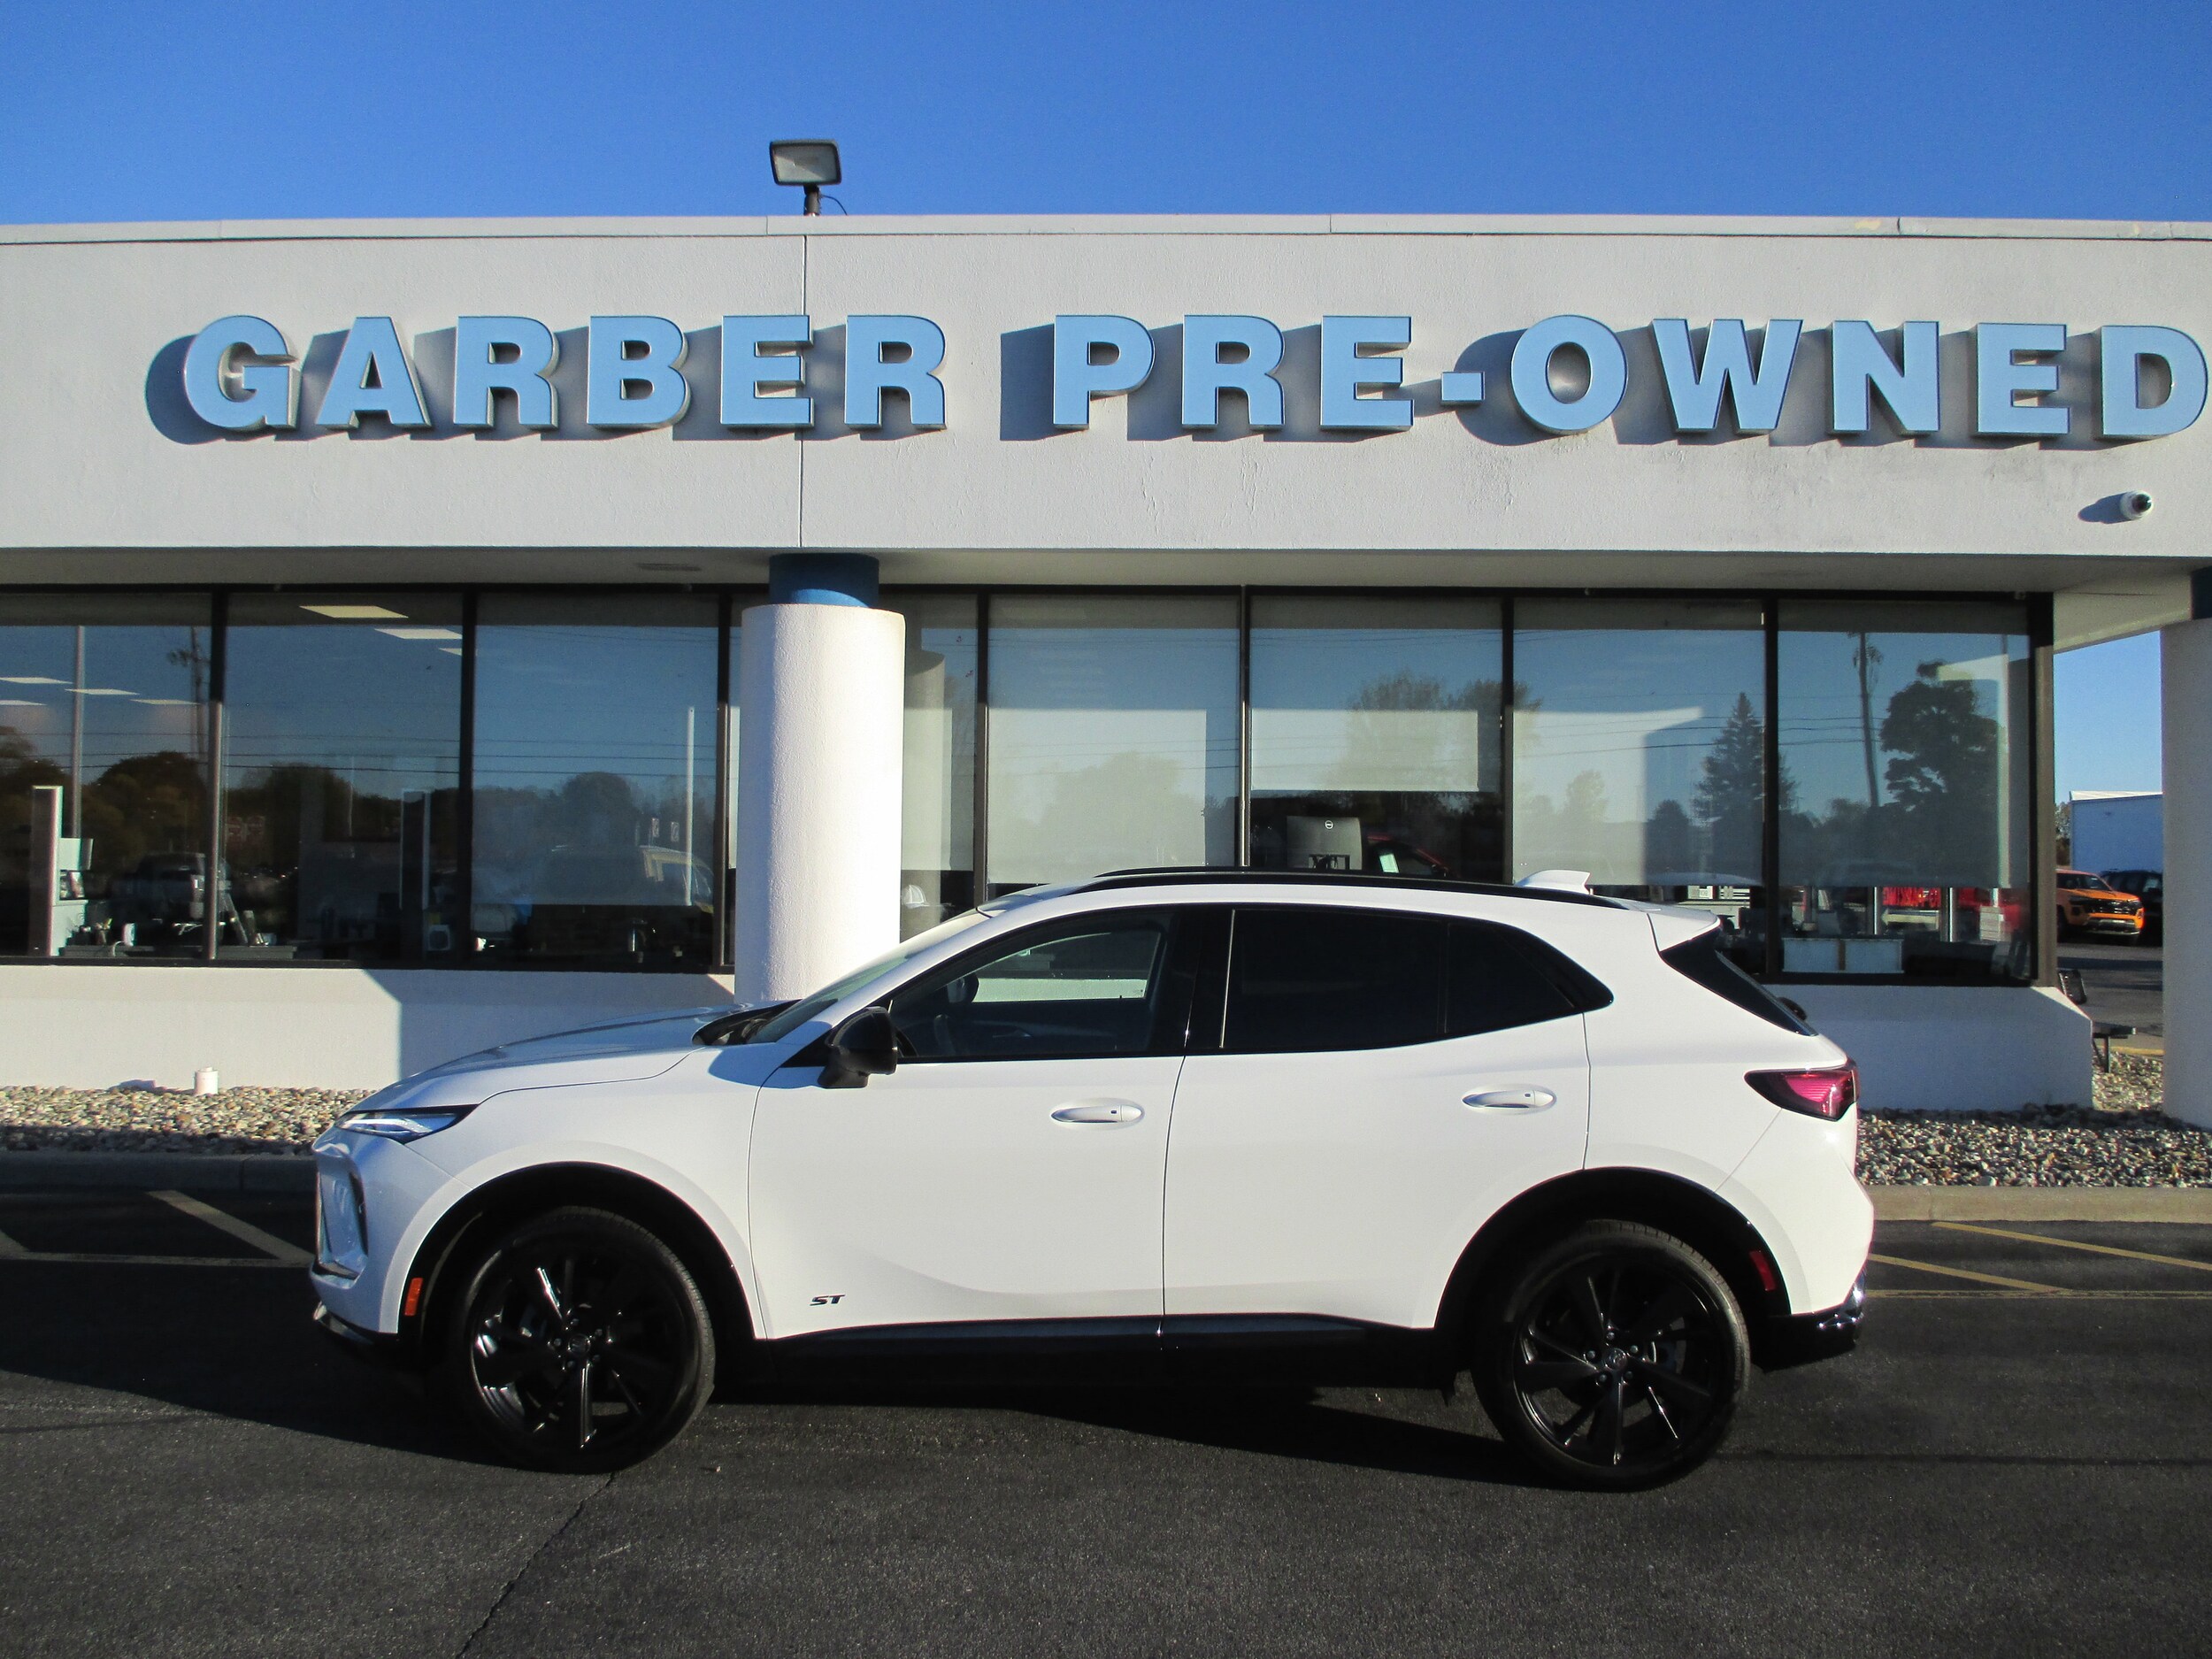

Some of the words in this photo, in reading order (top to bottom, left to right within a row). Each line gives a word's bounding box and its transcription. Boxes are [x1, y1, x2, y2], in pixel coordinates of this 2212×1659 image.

[182, 315, 946, 431] GARBER
[1051, 315, 2207, 440] PRE-OWNED
[810, 1294, 846, 1306] ST
